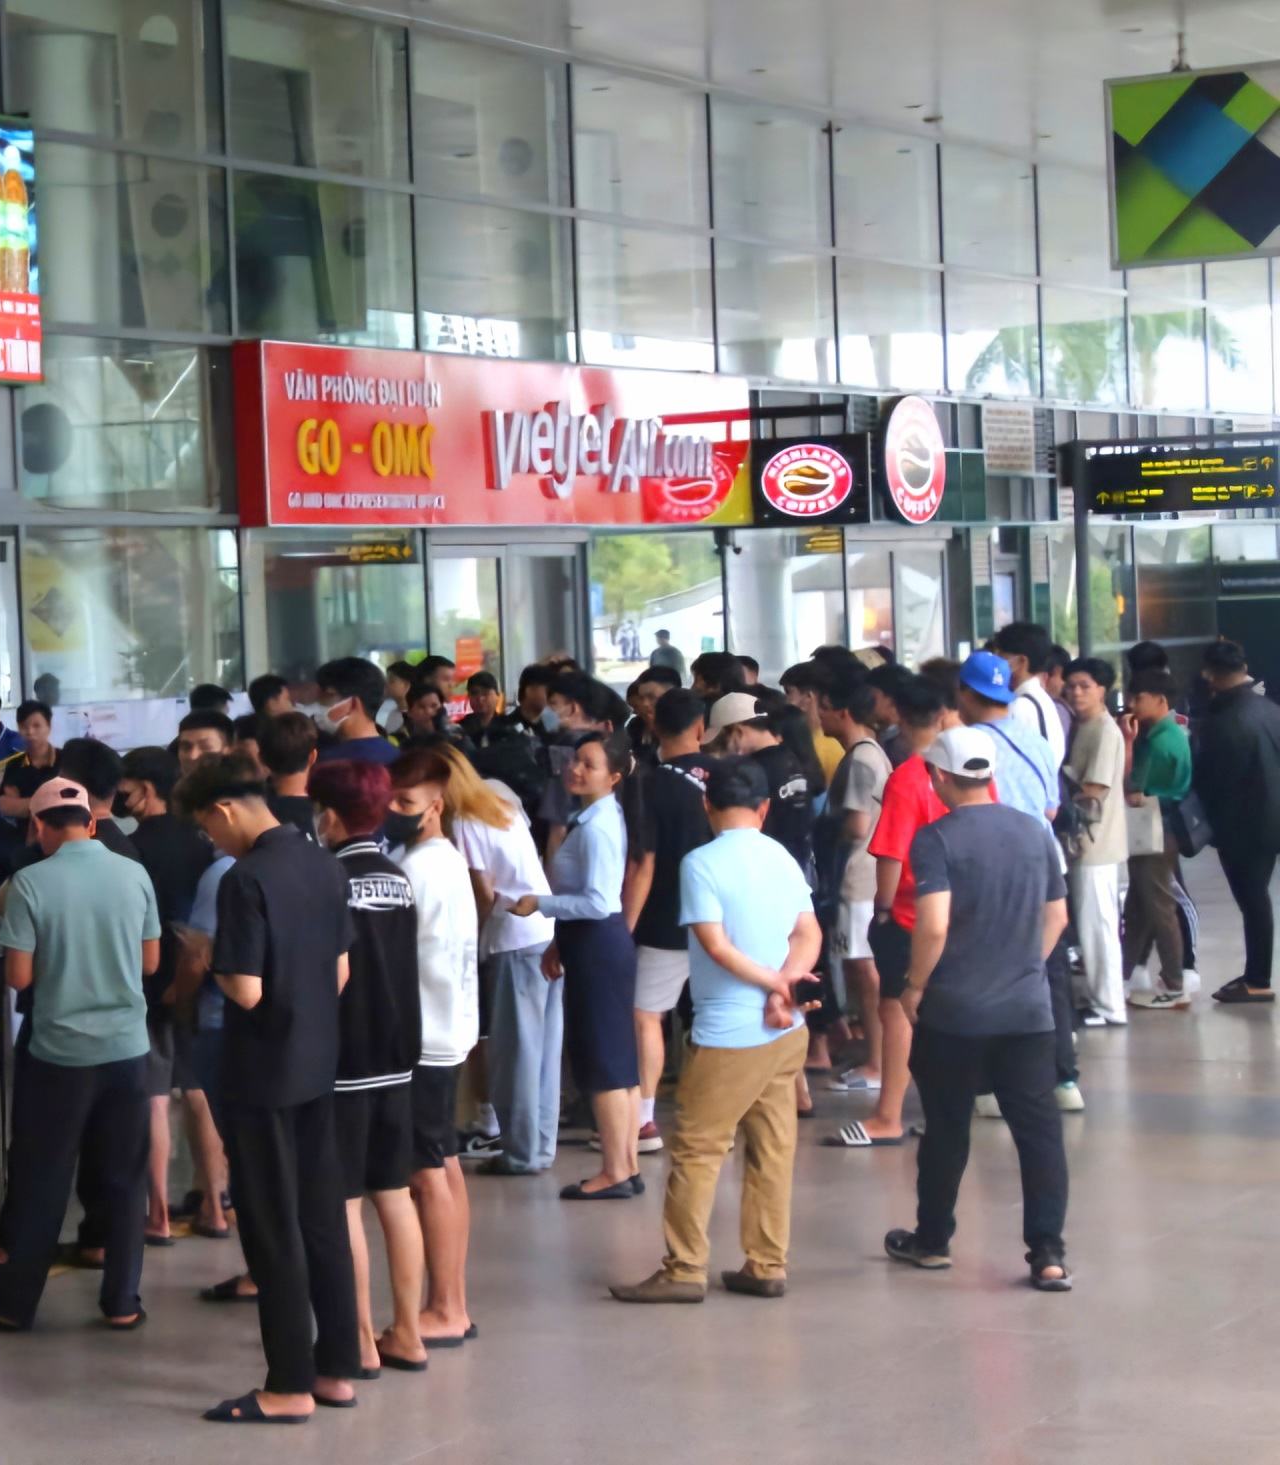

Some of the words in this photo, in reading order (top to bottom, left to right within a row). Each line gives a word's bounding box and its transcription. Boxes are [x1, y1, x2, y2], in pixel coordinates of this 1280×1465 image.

[285, 368, 318, 401] VĂN
[321, 370, 376, 406] PHÒNG
[297, 418, 341, 476] GO
[372, 421, 436, 480] OMC
